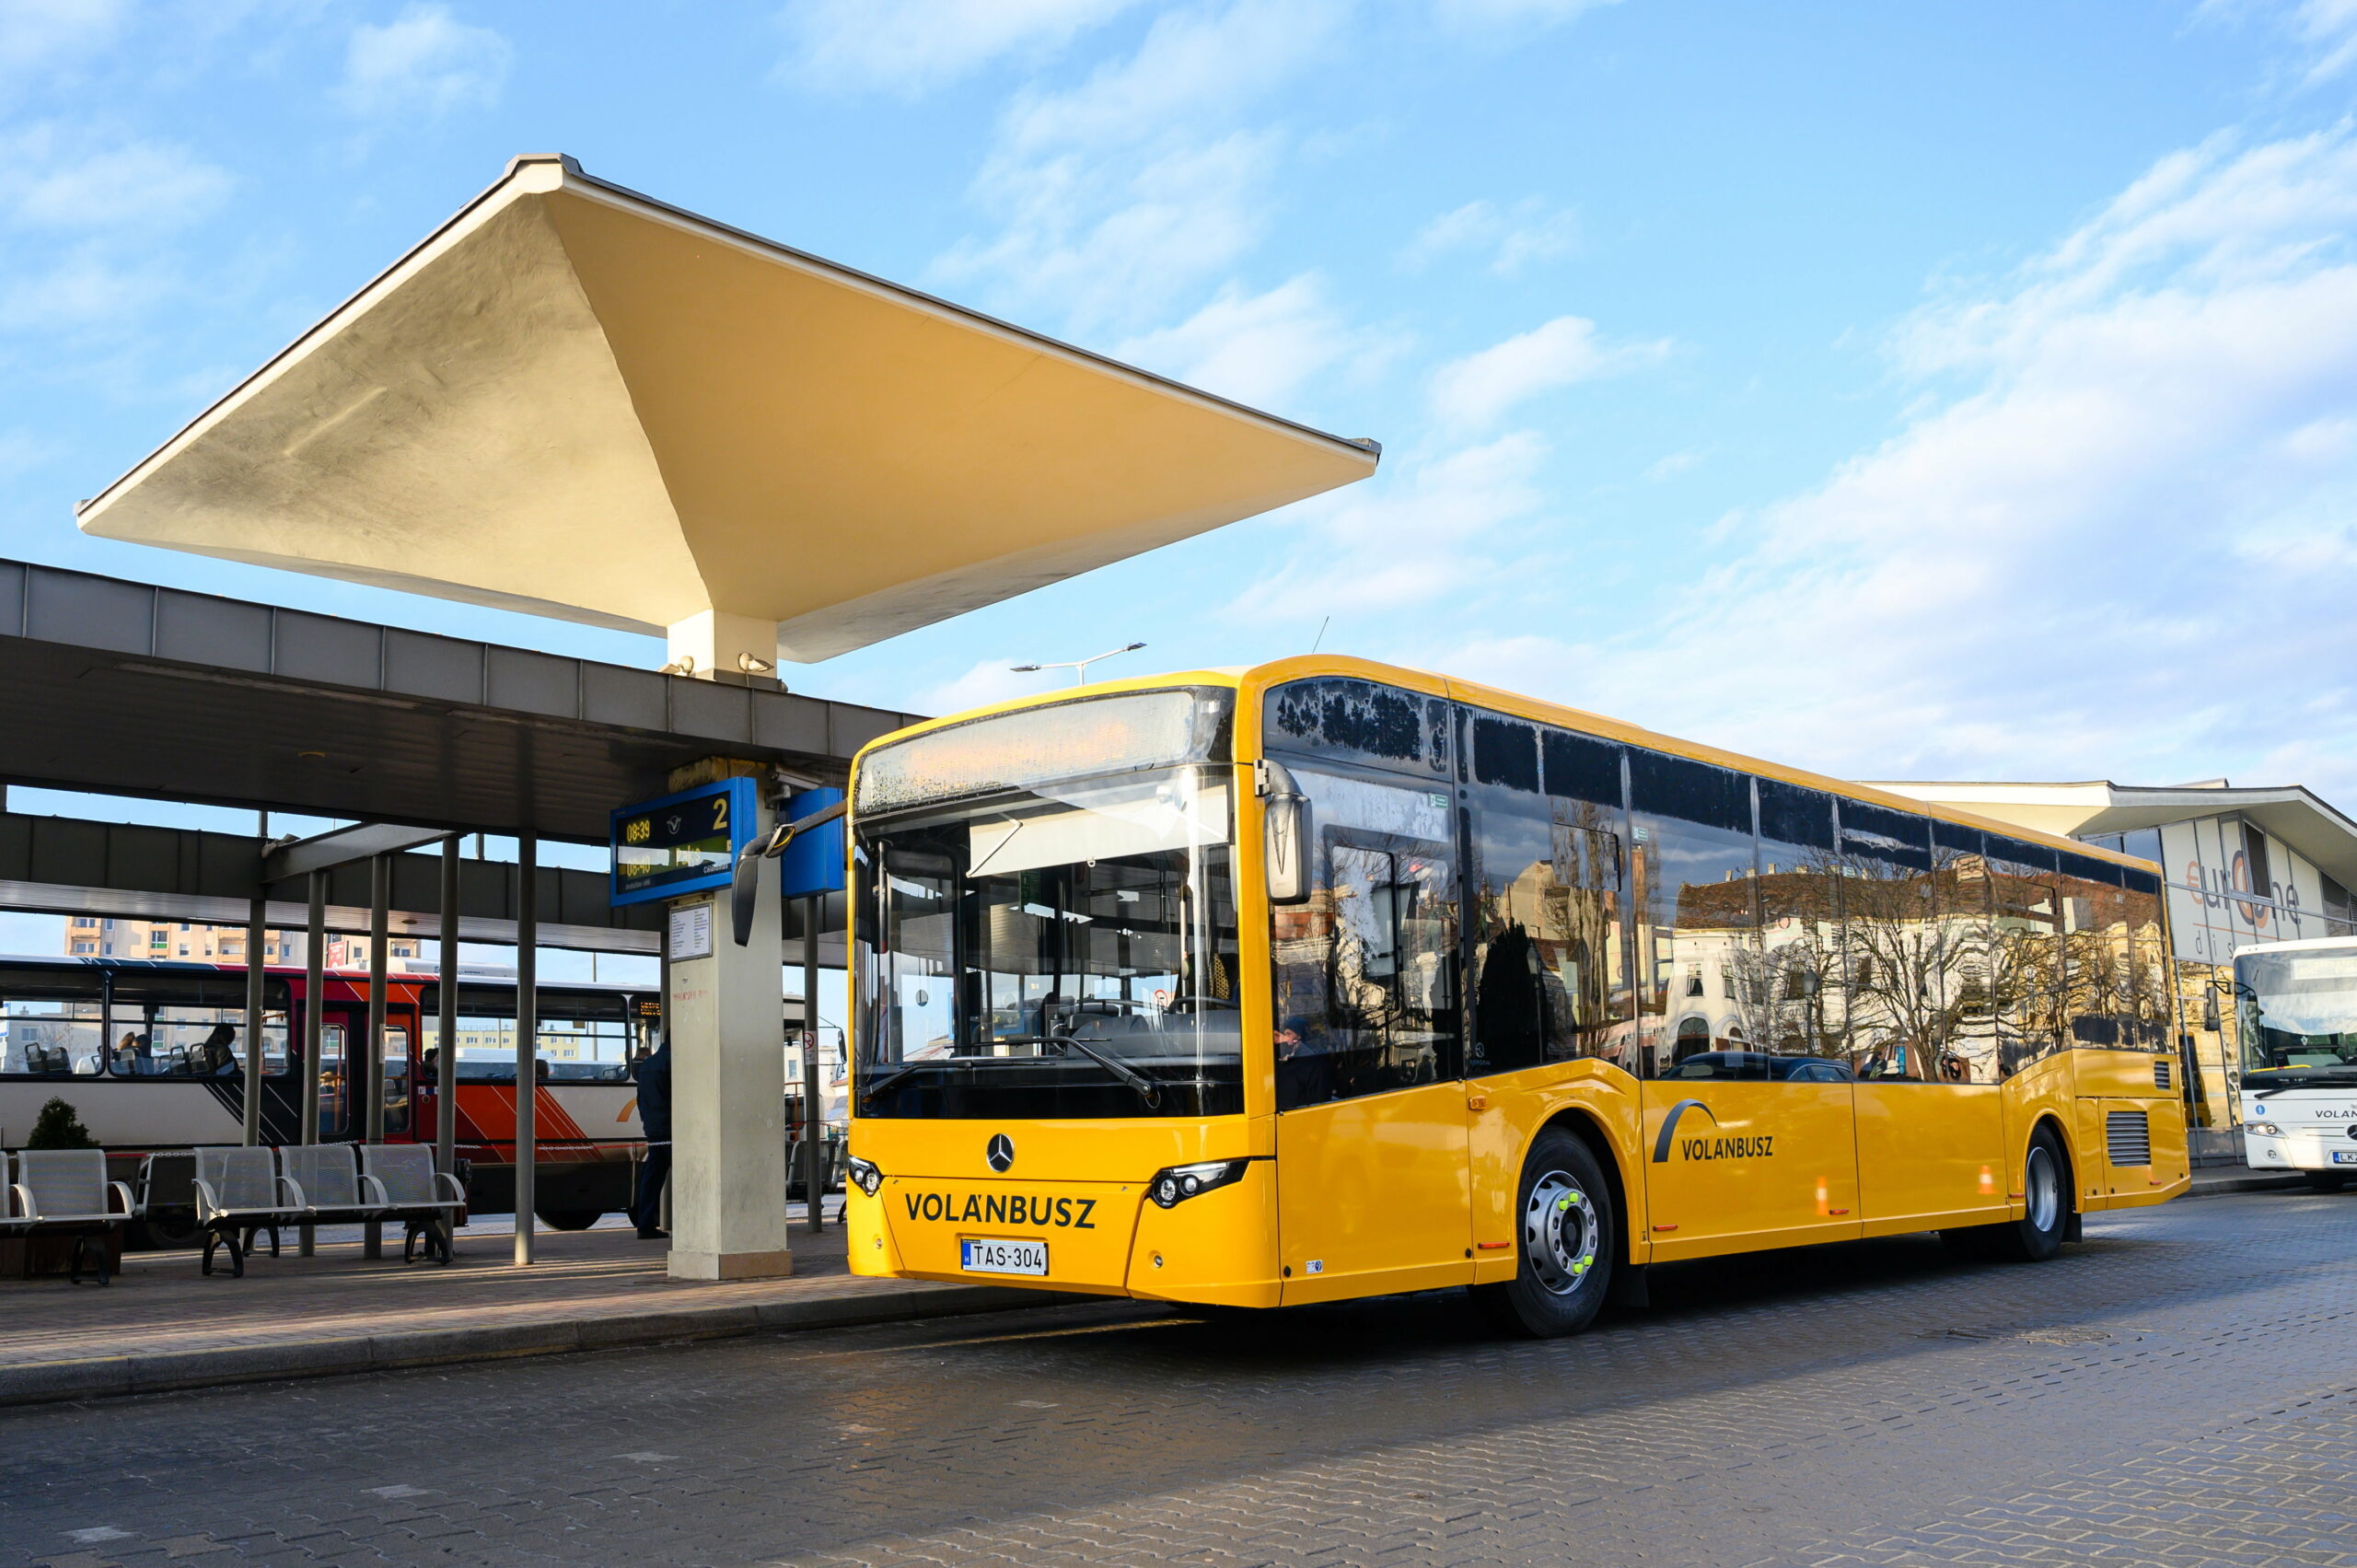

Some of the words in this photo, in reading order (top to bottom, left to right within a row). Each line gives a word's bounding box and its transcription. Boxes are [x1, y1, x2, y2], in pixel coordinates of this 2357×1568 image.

[713, 797, 727, 830] 2
[626, 819, 650, 842] 08:39
[1682, 1136, 1773, 1161] VOLÁNBUSZ
[905, 1193, 1097, 1229] VOLÁNBUSZ
[974, 1246, 1042, 1269] TAS-304
